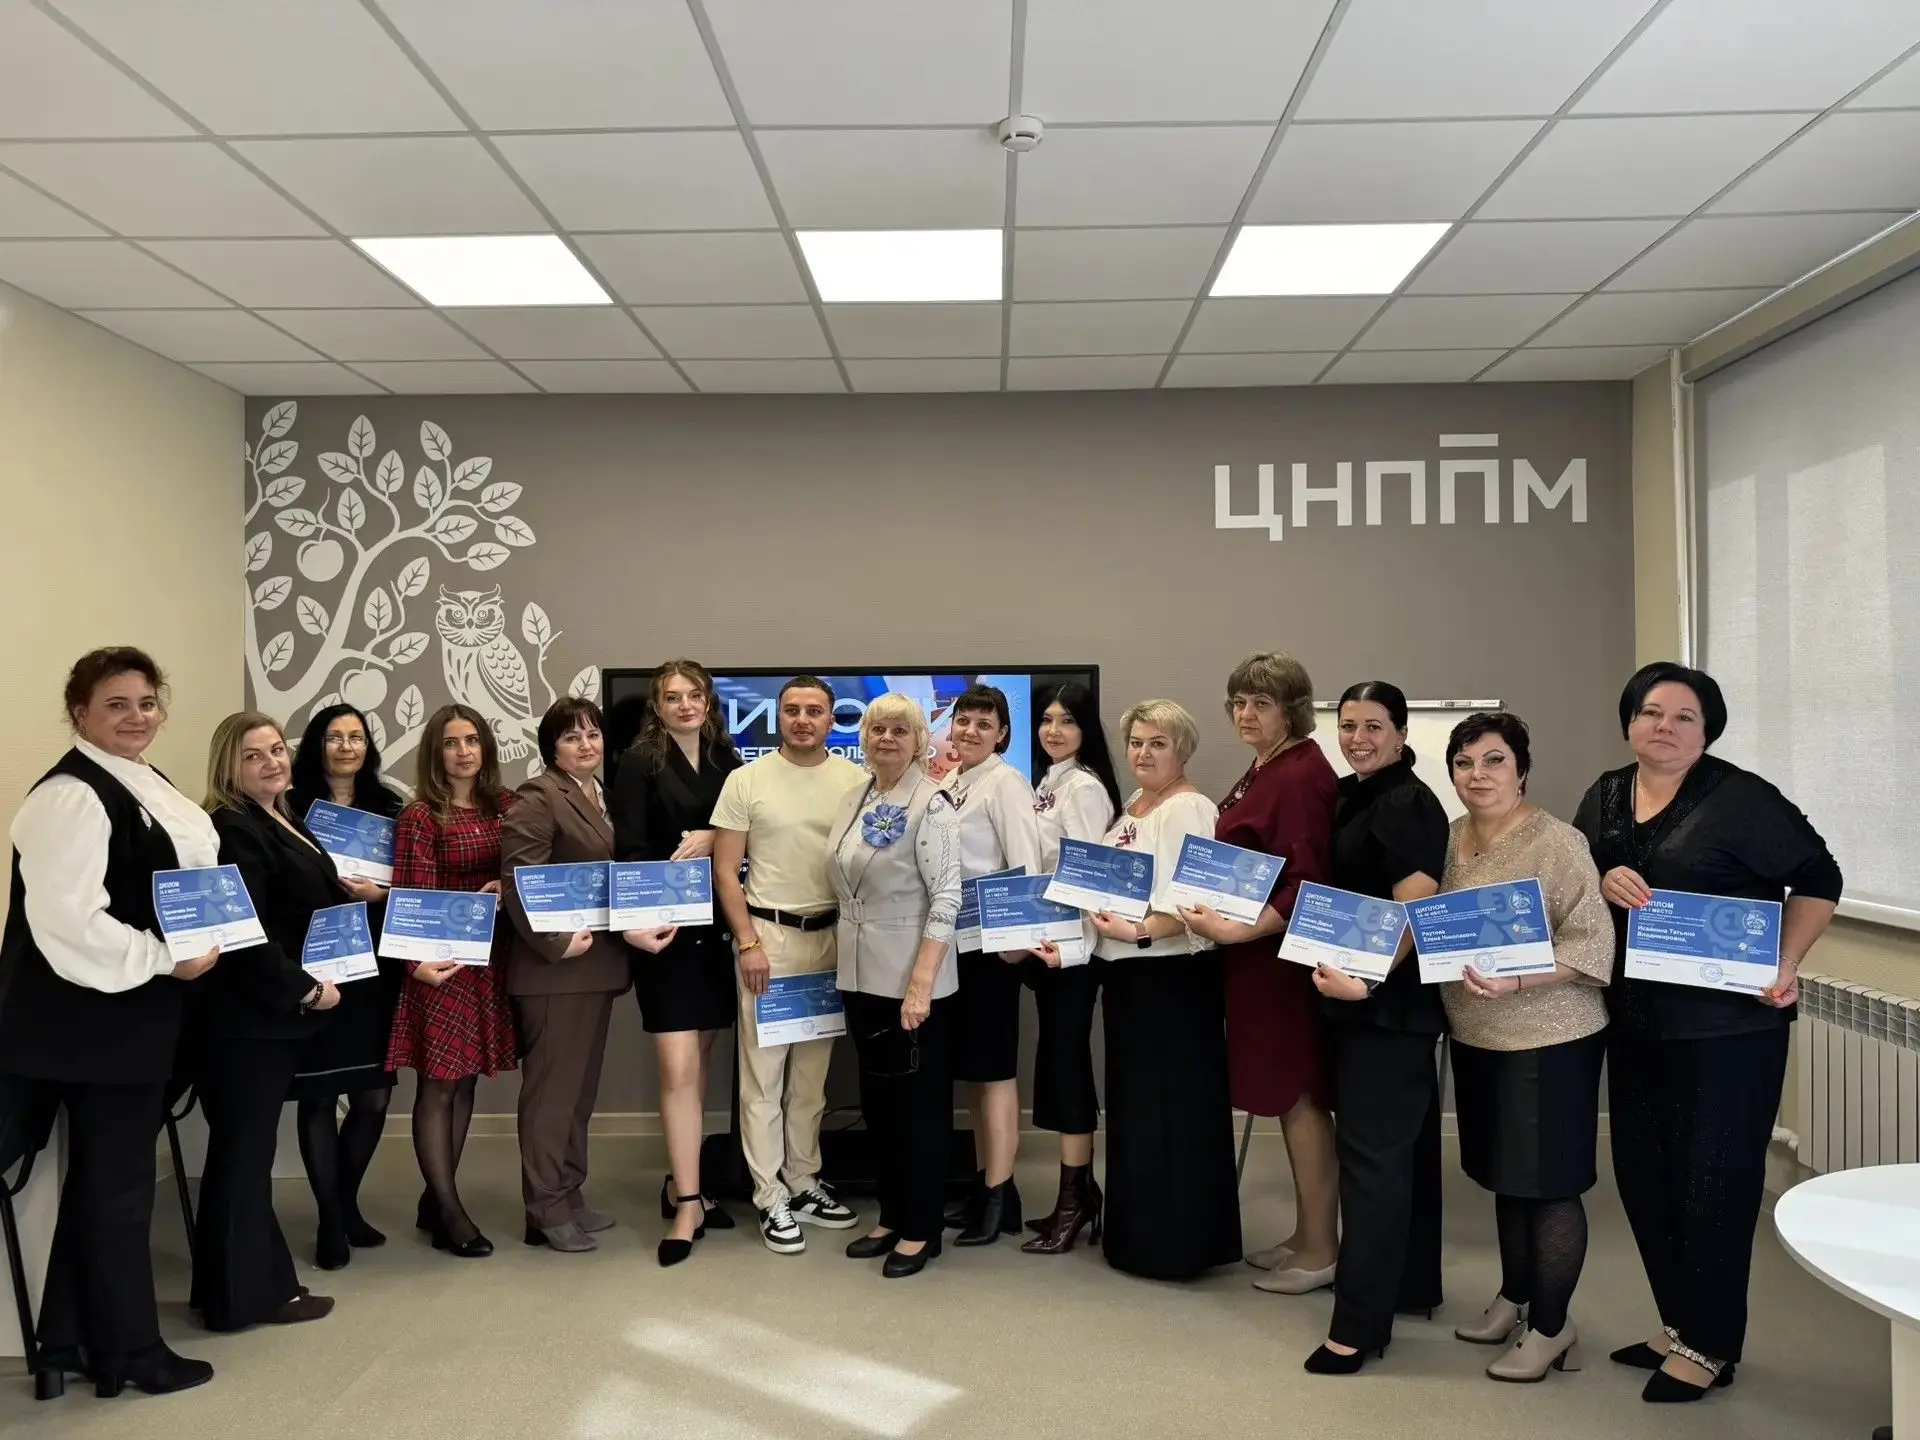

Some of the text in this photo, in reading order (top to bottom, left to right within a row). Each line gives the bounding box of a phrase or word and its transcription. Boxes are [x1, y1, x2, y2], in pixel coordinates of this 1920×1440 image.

[1214, 434, 1587, 541] ЦНППМ
[1188, 844, 1212, 854] ДИПЛОМ
[1415, 904, 1446, 914] ДИПЛОМ
